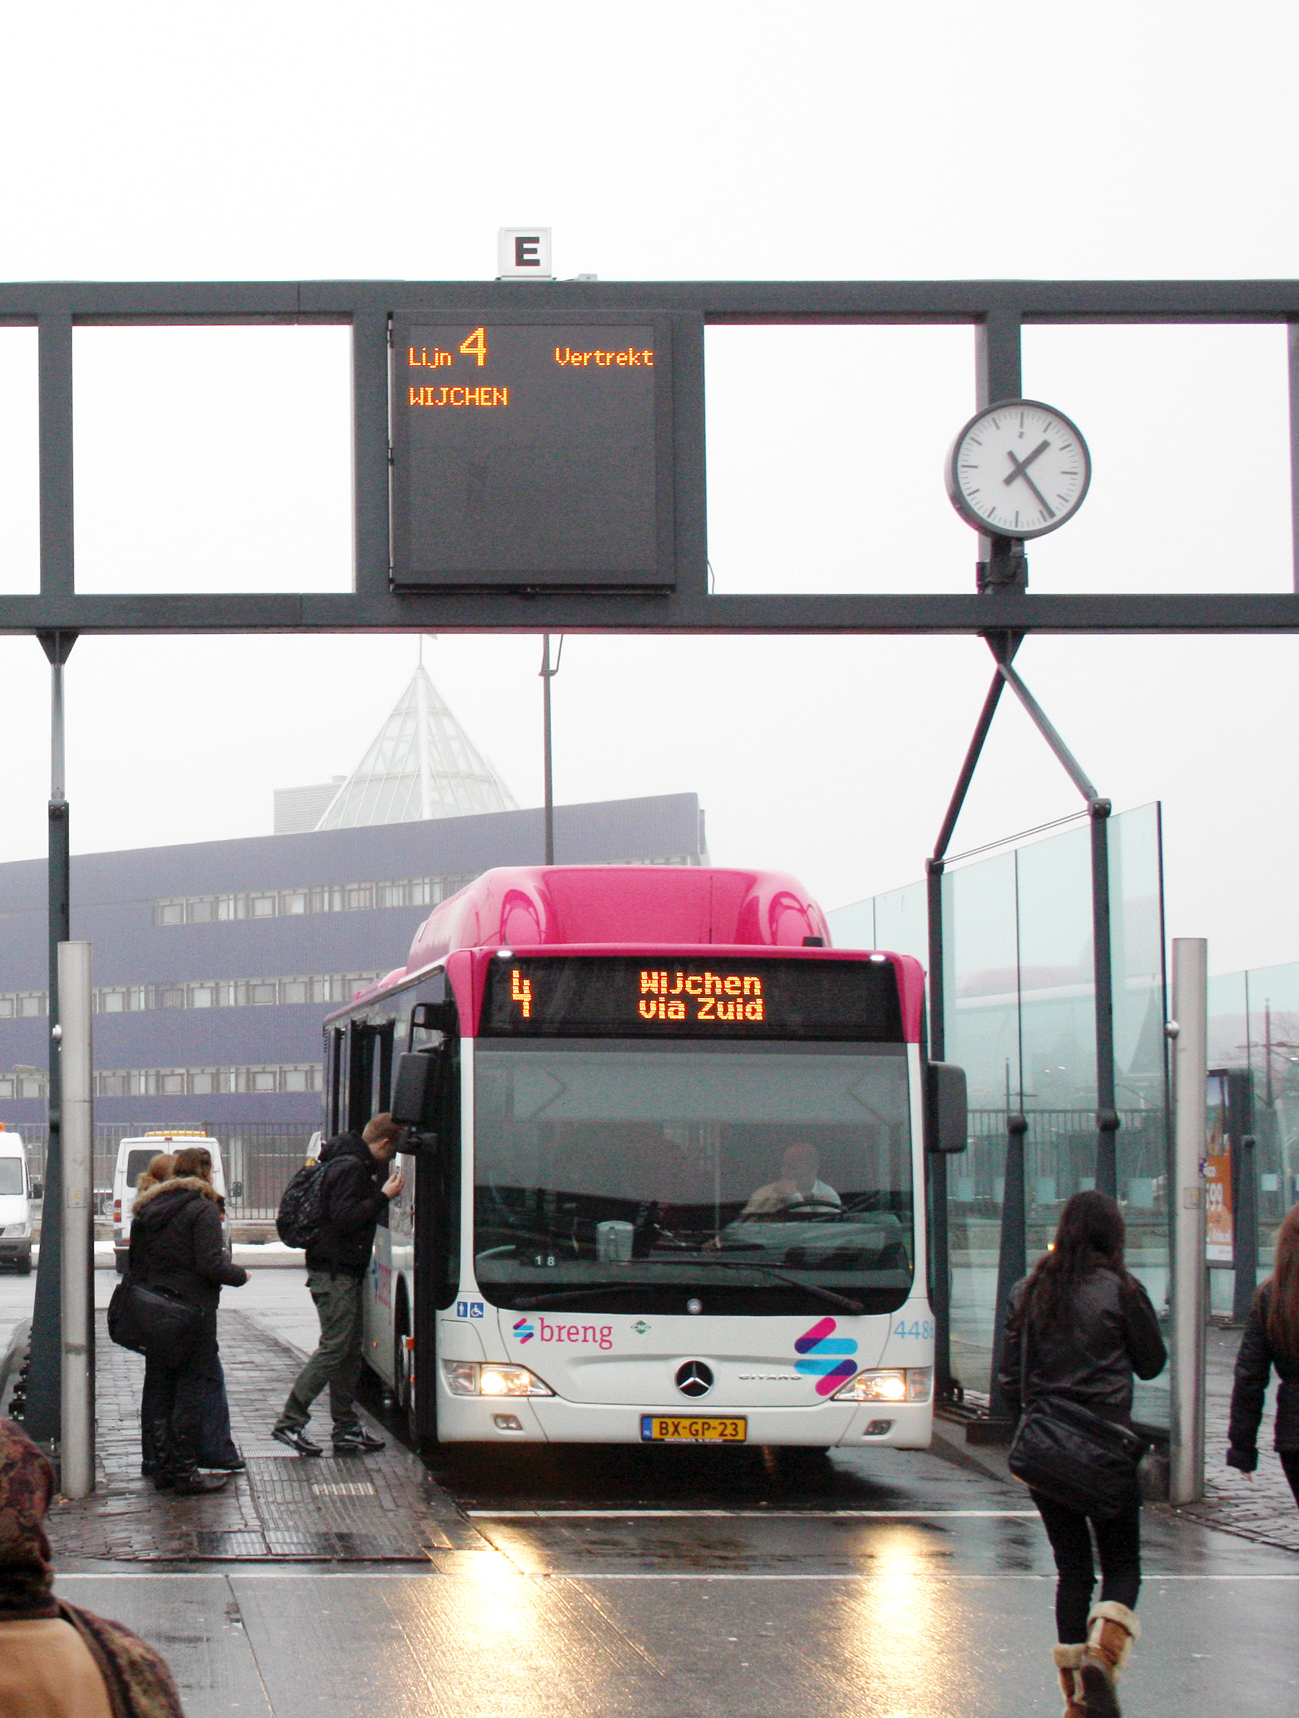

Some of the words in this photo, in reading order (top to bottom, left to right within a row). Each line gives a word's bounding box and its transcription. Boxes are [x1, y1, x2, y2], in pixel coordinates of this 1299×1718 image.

[515, 236, 540, 266] E
[408, 347, 453, 369] Lijn
[458, 326, 487, 367] 4
[554, 347, 654, 367] Vertrekt
[408, 386, 509, 406] WIJCHEN
[512, 969, 531, 1018] 4
[640, 971, 762, 995] Wijchen
[639, 997, 687, 1020] via
[697, 997, 764, 1020] Zuid
[538, 1317, 613, 1350] breng
[659, 1421, 739, 1437] BX-GP-23
